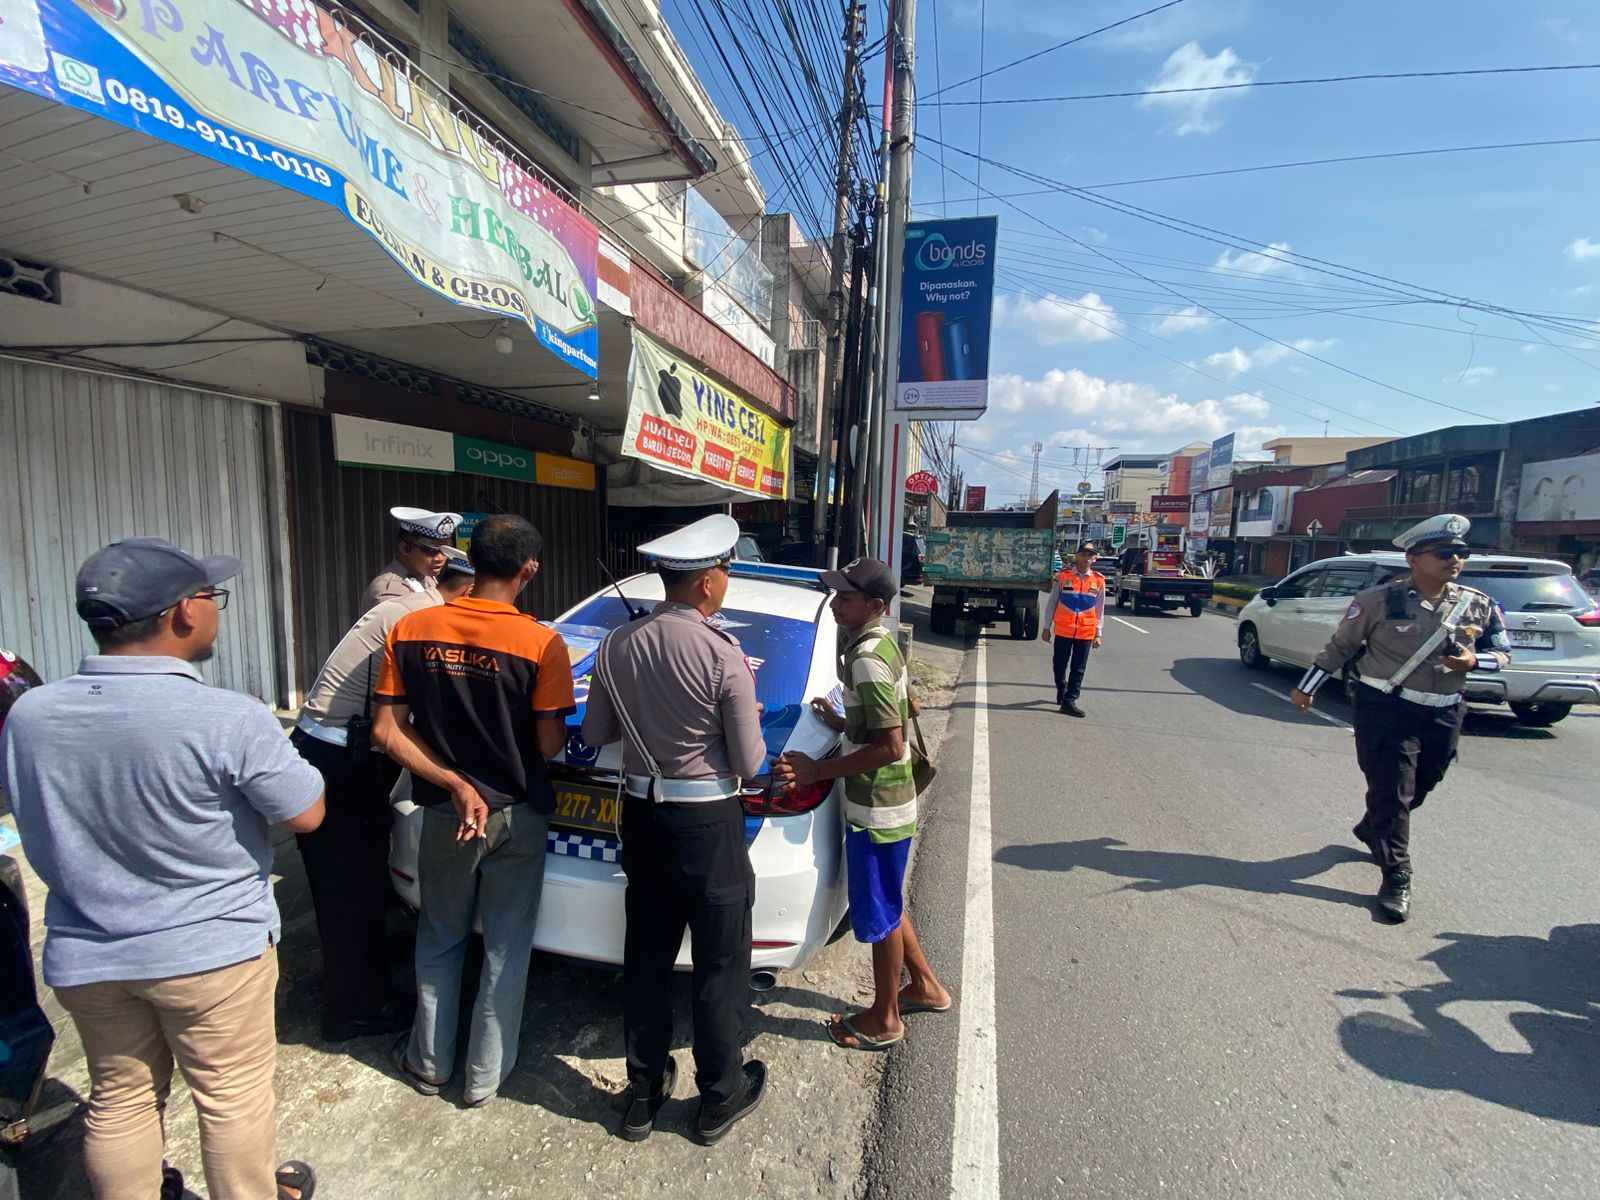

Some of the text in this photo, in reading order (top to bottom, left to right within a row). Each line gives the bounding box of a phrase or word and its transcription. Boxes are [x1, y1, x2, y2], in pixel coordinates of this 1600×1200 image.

[105, 78, 332, 188] 0819-9111-0119
[137, 0, 410, 202] PARFUME
[448, 194, 568, 308] HERBAL
[929, 240, 986, 262] bonds
[432, 266, 446, 289] &
[920, 280, 978, 292] Dipanaskan.
[926, 291, 970, 303] Why not?
[692, 376, 736, 429] YINS
[738, 407, 766, 445] CELL
[643, 421, 673, 441] JUAL
[365, 431, 433, 458] Infinix
[424, 647, 501, 672] YASUKA
